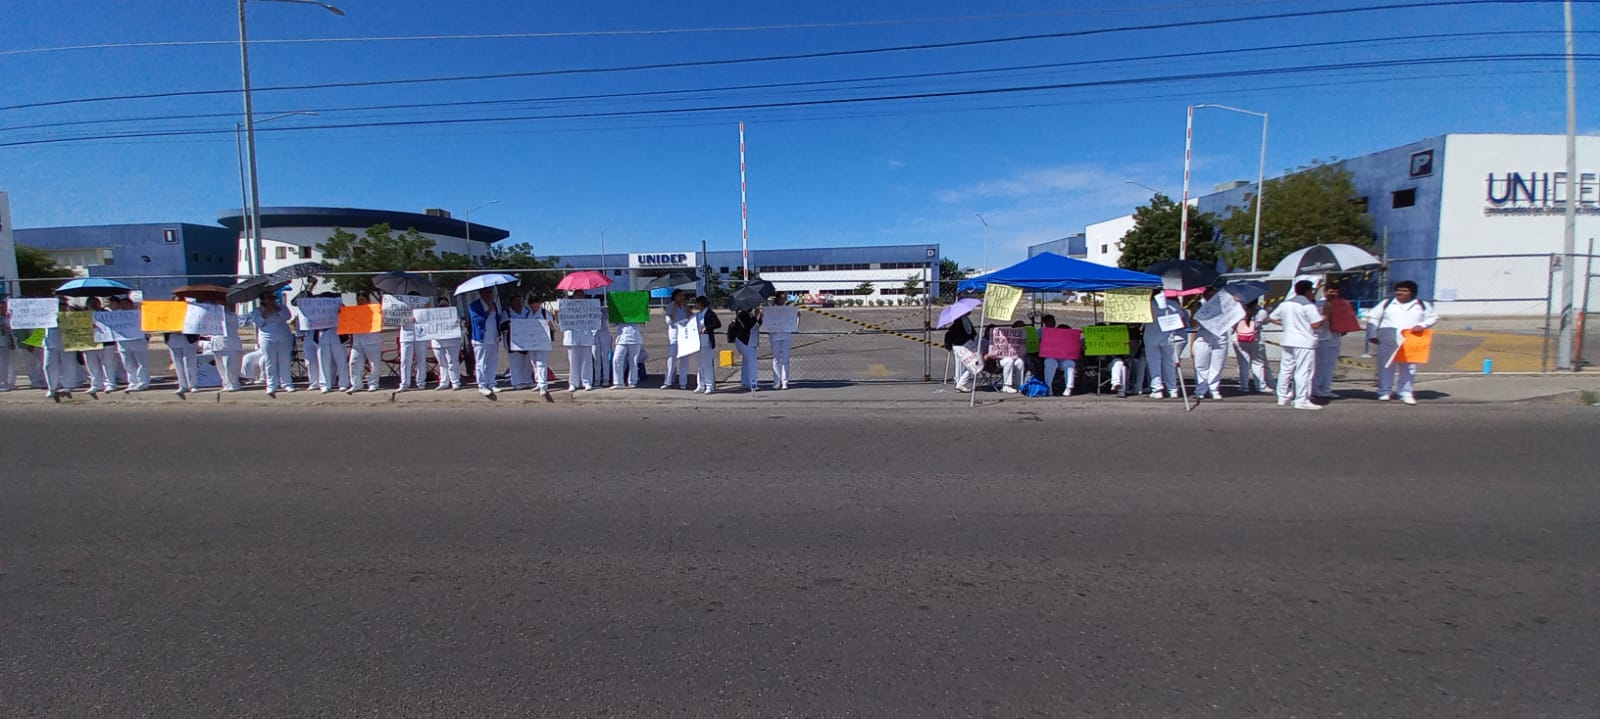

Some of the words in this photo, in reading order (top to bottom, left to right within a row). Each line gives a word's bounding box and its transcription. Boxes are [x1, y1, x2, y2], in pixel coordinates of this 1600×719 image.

[1412, 154, 1431, 174] P
[1487, 172, 1600, 206] UNIDE
[637, 253, 688, 265] UNIDEP
